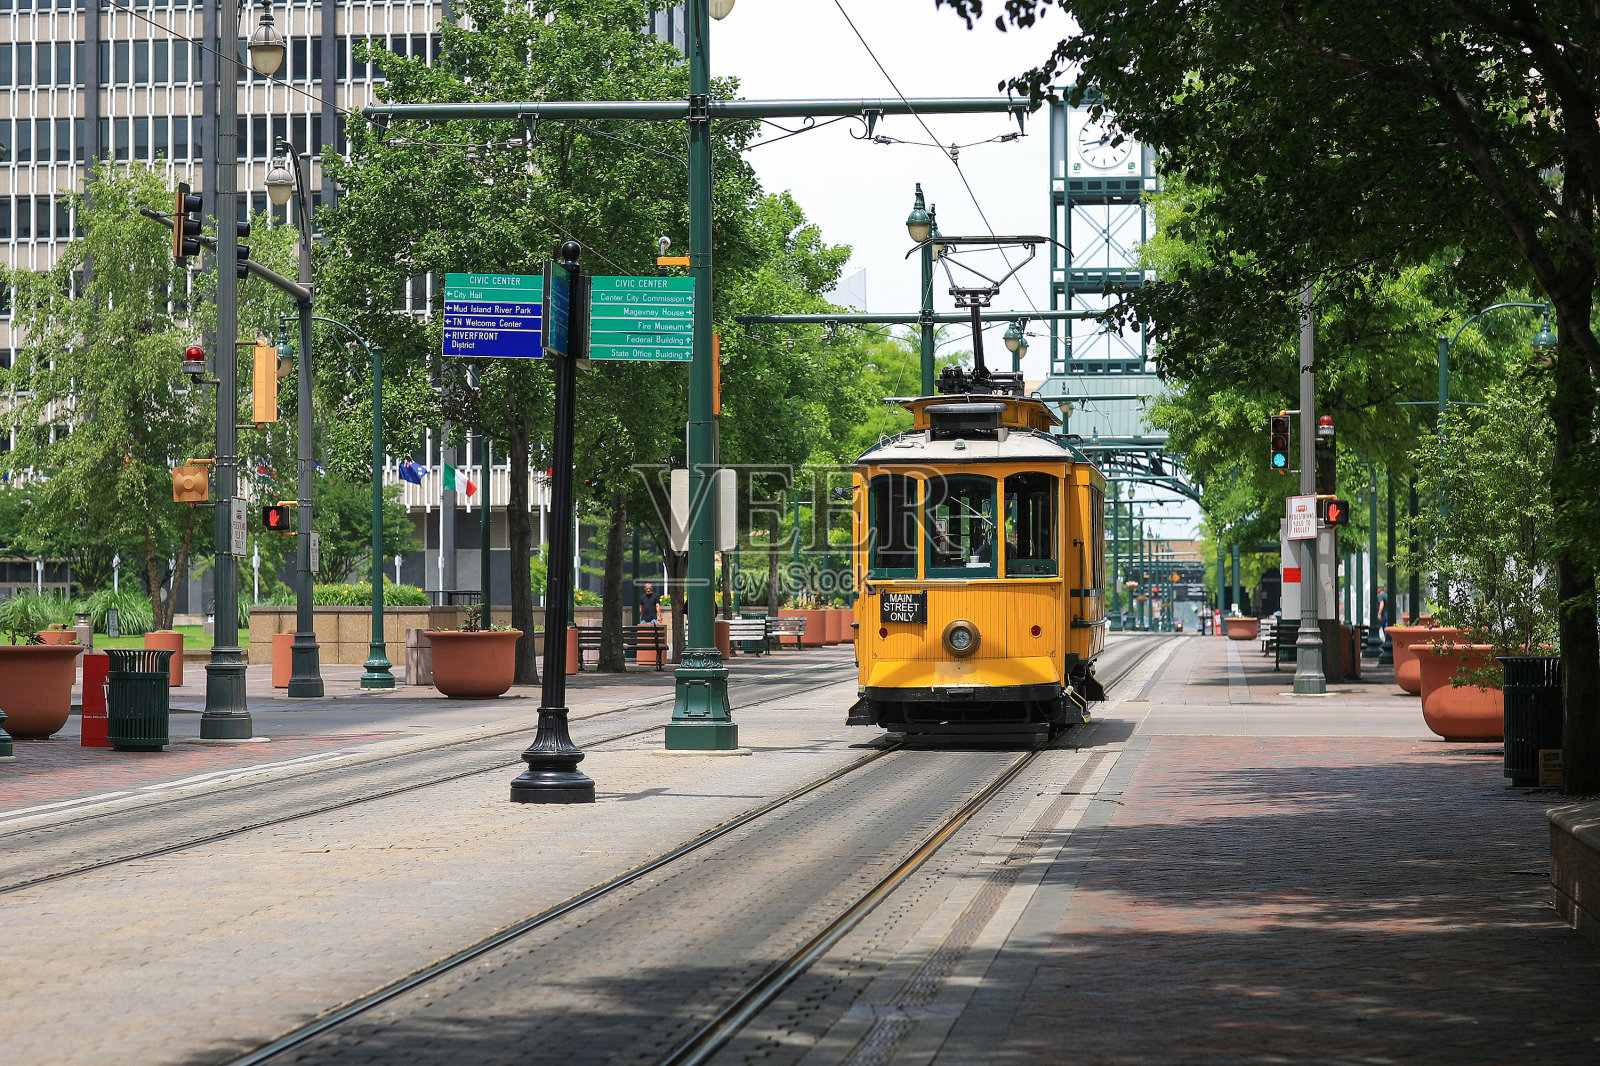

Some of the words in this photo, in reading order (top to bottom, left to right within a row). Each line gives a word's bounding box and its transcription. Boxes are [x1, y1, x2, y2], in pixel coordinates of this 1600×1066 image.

[469, 276, 489, 284] CIVIC
[492, 277, 521, 286] CENTER
[615, 279, 635, 288] CIVIC
[638, 279, 668, 288] CENTER
[453, 290, 467, 300] City
[469, 291, 483, 299] Hall
[600, 293, 624, 301] Center
[626, 293, 640, 302] City
[642, 293, 685, 303] Commission
[453, 304, 468, 313] Mud
[470, 304, 492, 314] Island
[494, 305, 513, 314] River
[515, 305, 532, 314] Park
[623, 307, 659, 317] Magevney
[662, 308, 685, 317] House
[452, 317, 463, 326] TN
[465, 318, 497, 327] Welcome
[499, 318, 522, 328] Center
[637, 321, 652, 330] Fire
[654, 322, 684, 331] Museum
[452, 331, 499, 341] RIVERFRONT
[626, 334, 653, 343] Federal
[656, 335, 684, 345] Building
[451, 340, 475, 349] District
[611, 348, 629, 357] State
[632, 348, 652, 358] Office
[655, 349, 683, 359] Building
[890, 594, 912, 603] MAIN
[883, 602, 920, 612] STREET
[890, 612, 915, 622] ONLY
